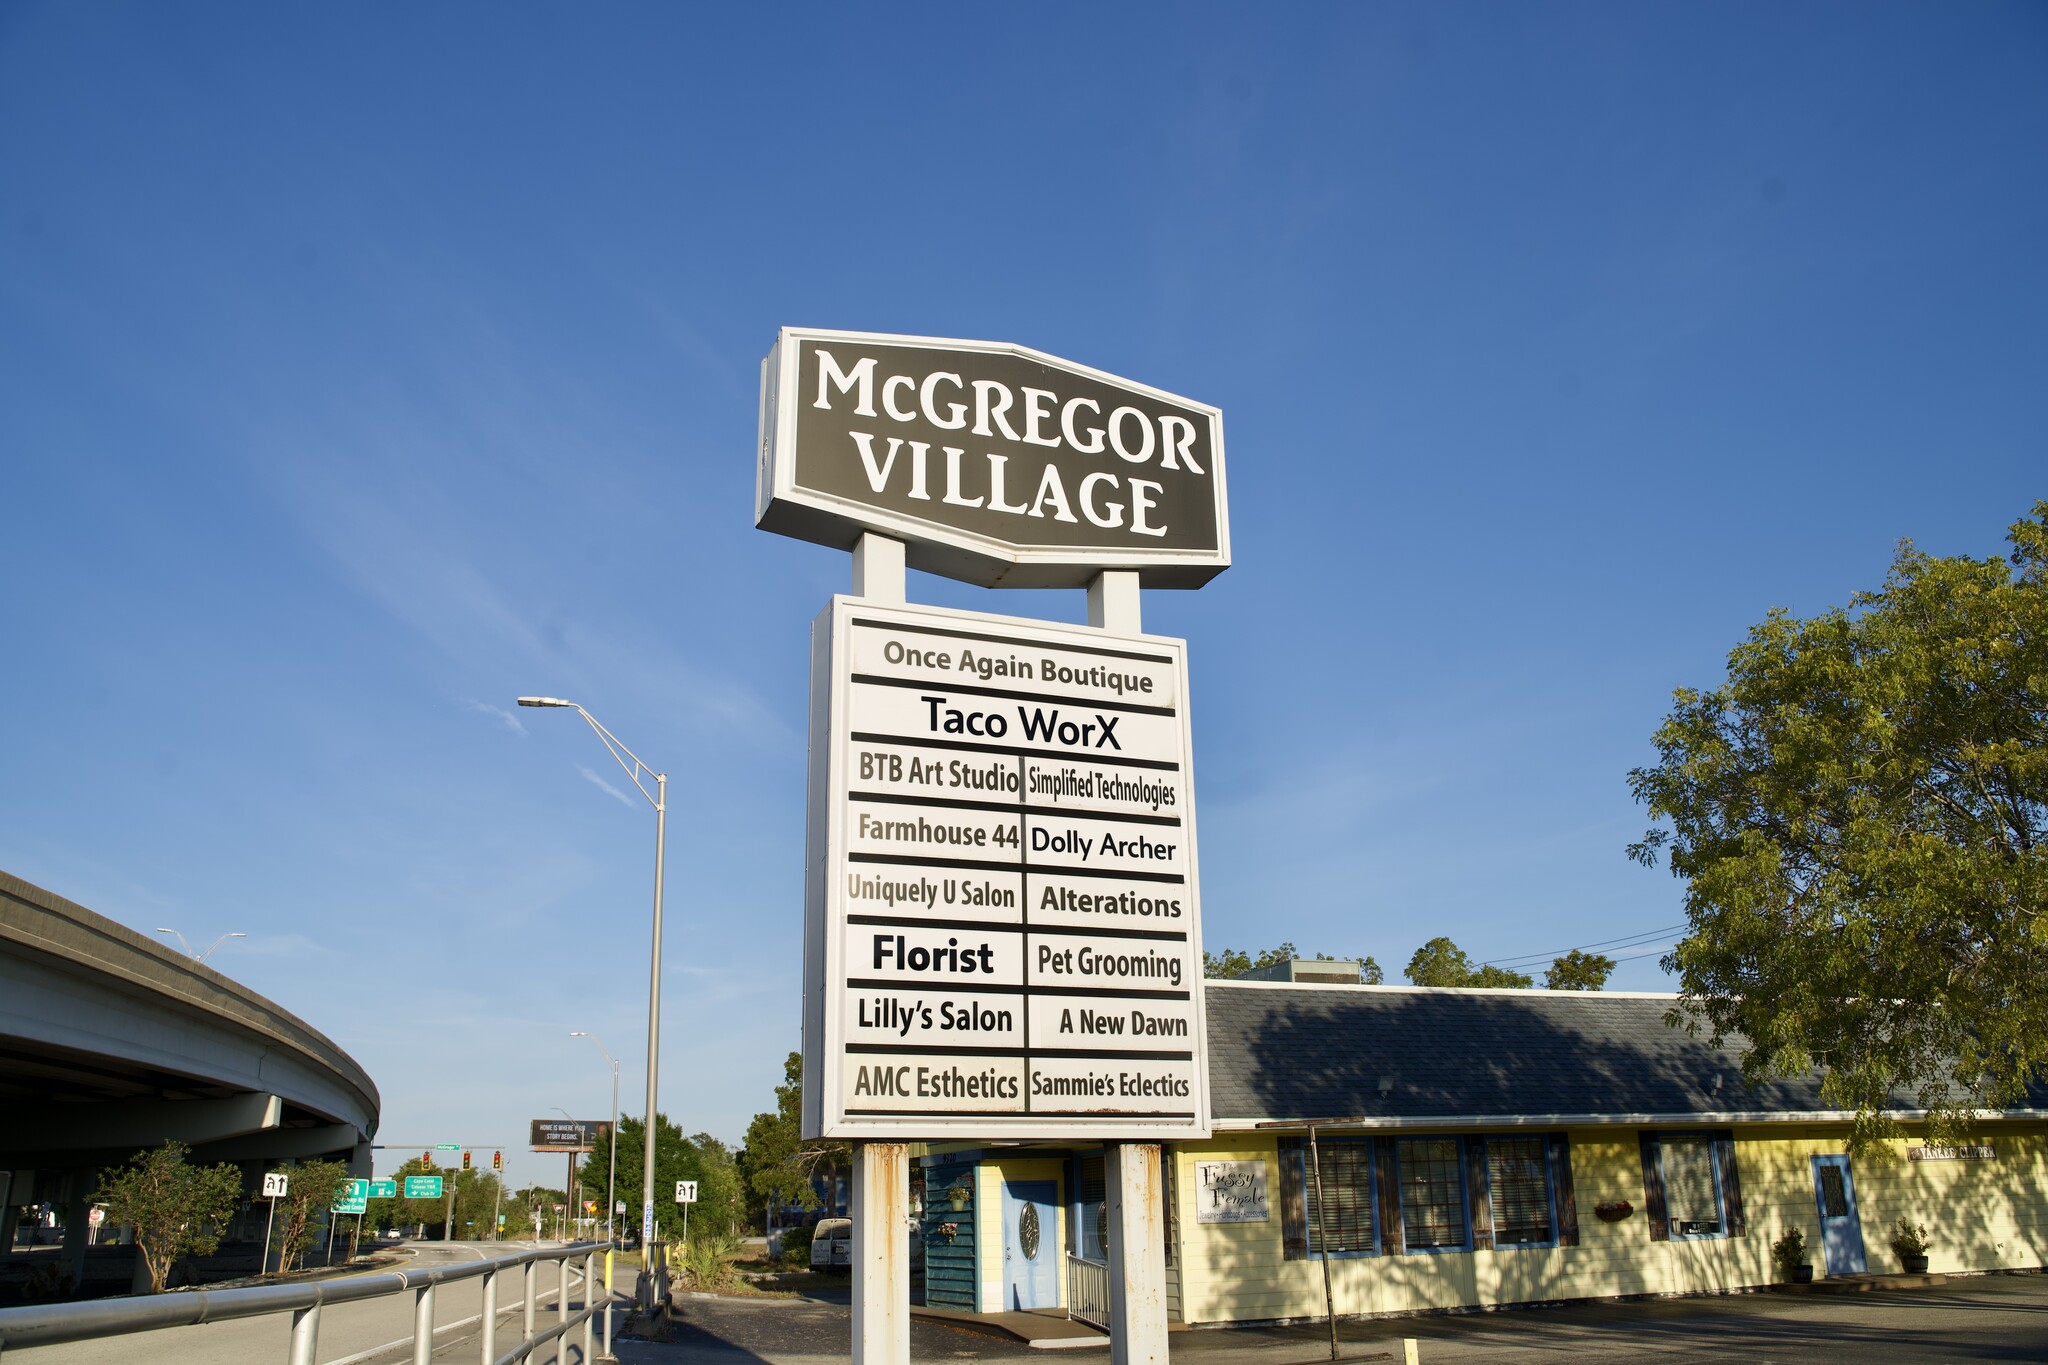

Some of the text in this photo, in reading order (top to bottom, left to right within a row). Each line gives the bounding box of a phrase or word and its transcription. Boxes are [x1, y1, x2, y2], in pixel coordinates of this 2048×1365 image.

[813, 349, 1205, 475] McGREGOR
[849, 430, 1168, 538] VILLAGE
[883, 641, 1153, 695] Once Again Boutique
[921, 696, 1121, 750] Taco WorX
[860, 752, 1019, 793] BTB Art Studio
[1029, 766, 1176, 811] Simplified Technologies
[859, 813, 1019, 849] Farmhouse 44
[1032, 827, 1176, 861] Dolly Archer
[848, 873, 1015, 910] Uniquely U Salon
[1040, 886, 1181, 918] Alterations
[873, 934, 994, 974] Florist
[1038, 944, 1181, 986] Pet Grooming
[858, 998, 1012, 1037] Lilly's Salon
[1059, 1009, 1188, 1036] A New Dawn
[854, 1065, 1018, 1099] AMC Esthetics
[1032, 1071, 1189, 1097] Sammie's Eclectics
[1221, 1163, 1237, 1171] The
[1920, 1147, 1956, 1159] YANKEE
[1959, 1146, 1996, 1158] CLIPPER
[1199, 1165, 1255, 1189] Fussy
[1209, 1187, 1265, 1208] Female
